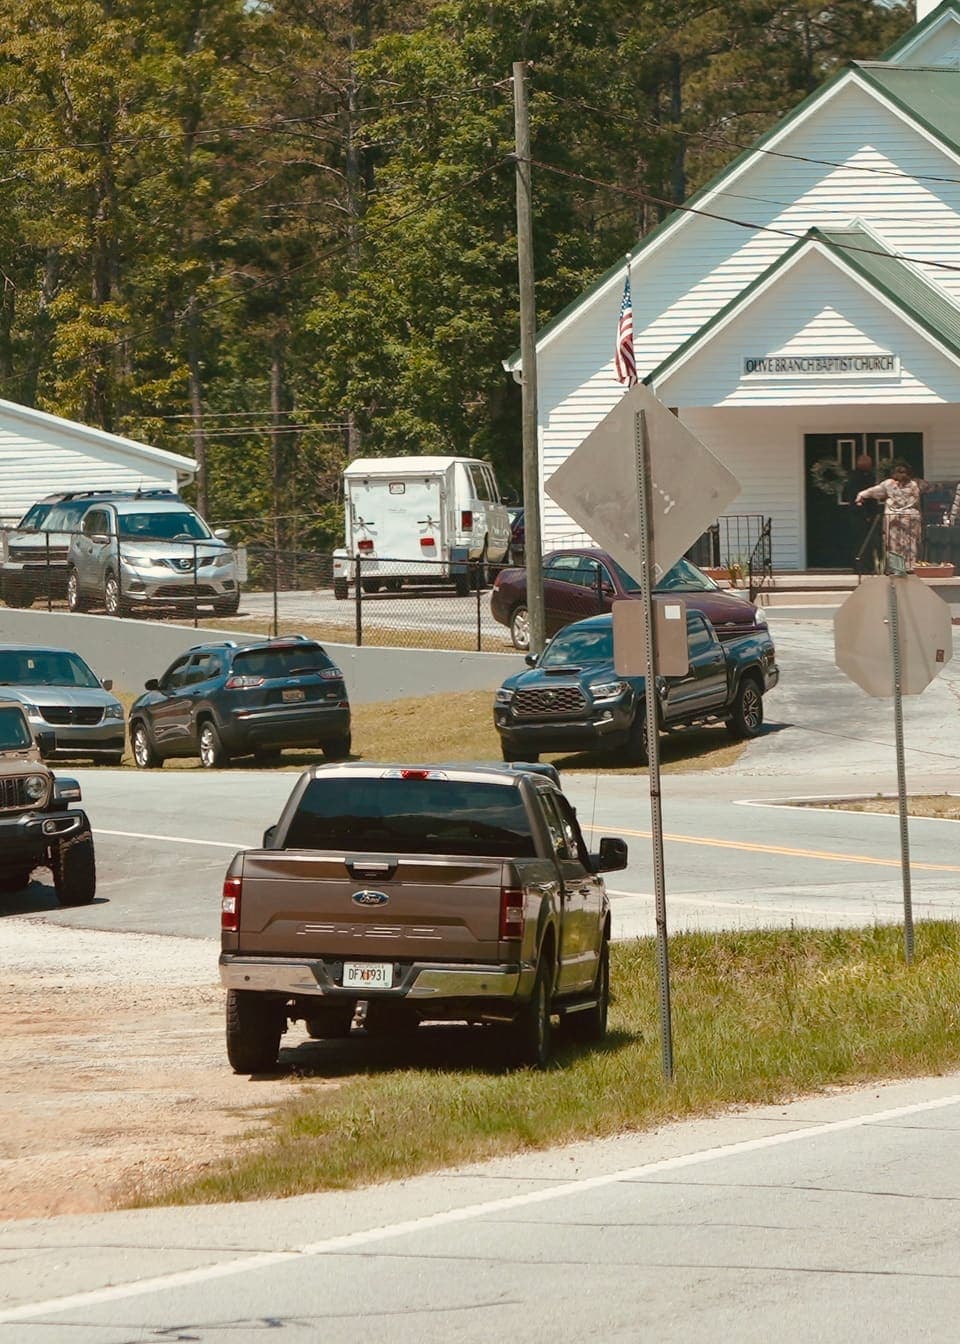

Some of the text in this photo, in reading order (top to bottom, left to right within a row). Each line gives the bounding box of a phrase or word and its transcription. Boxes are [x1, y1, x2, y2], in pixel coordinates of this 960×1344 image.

[746, 357, 894, 373] OLIVE BRANCH BAPTIST CHURCH
